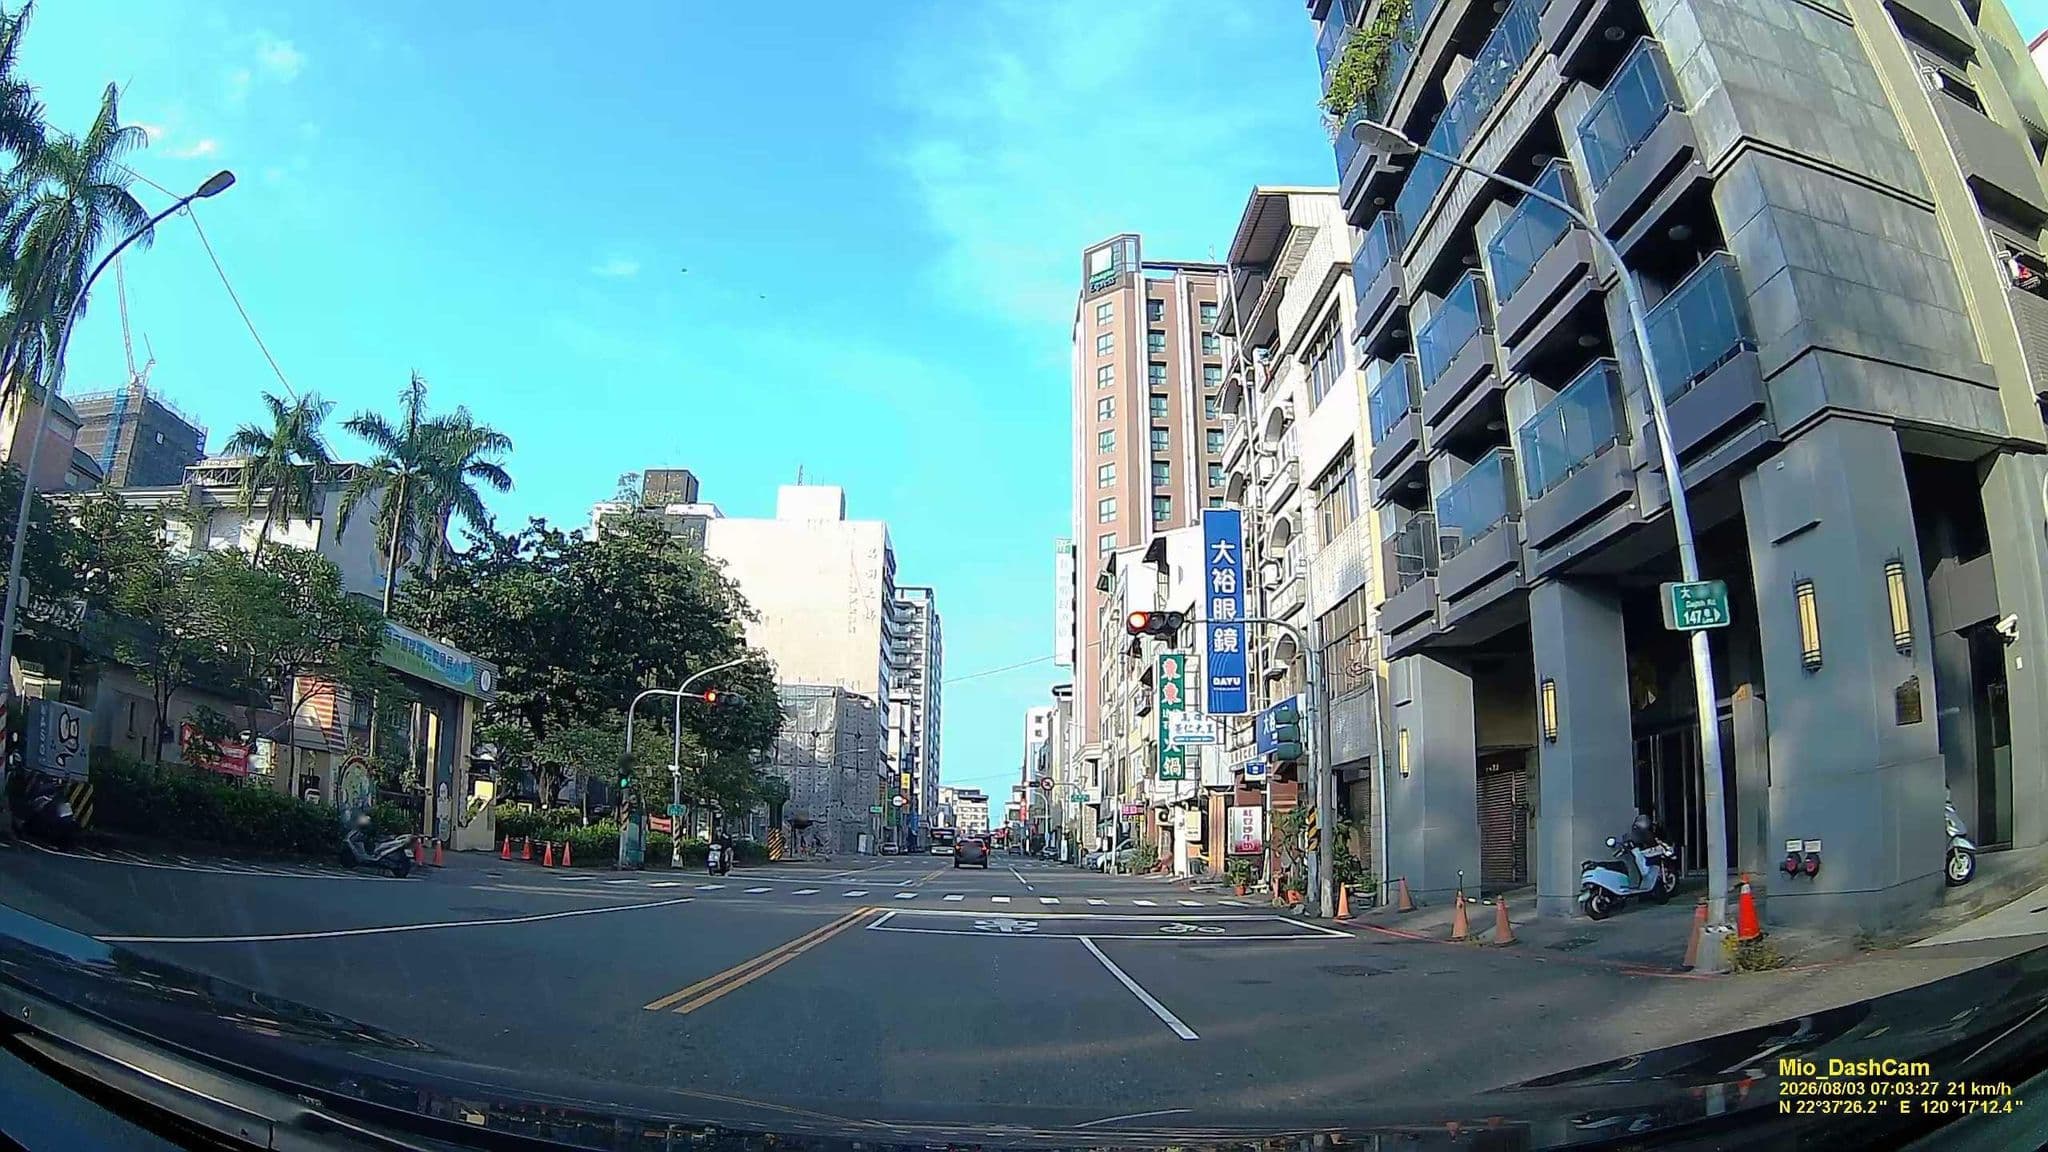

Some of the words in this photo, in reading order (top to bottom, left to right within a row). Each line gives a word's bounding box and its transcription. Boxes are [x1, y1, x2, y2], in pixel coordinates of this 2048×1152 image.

[1211, 540, 1239, 654] 大裕眼鏡
[1213, 677, 1241, 686] DAYU
